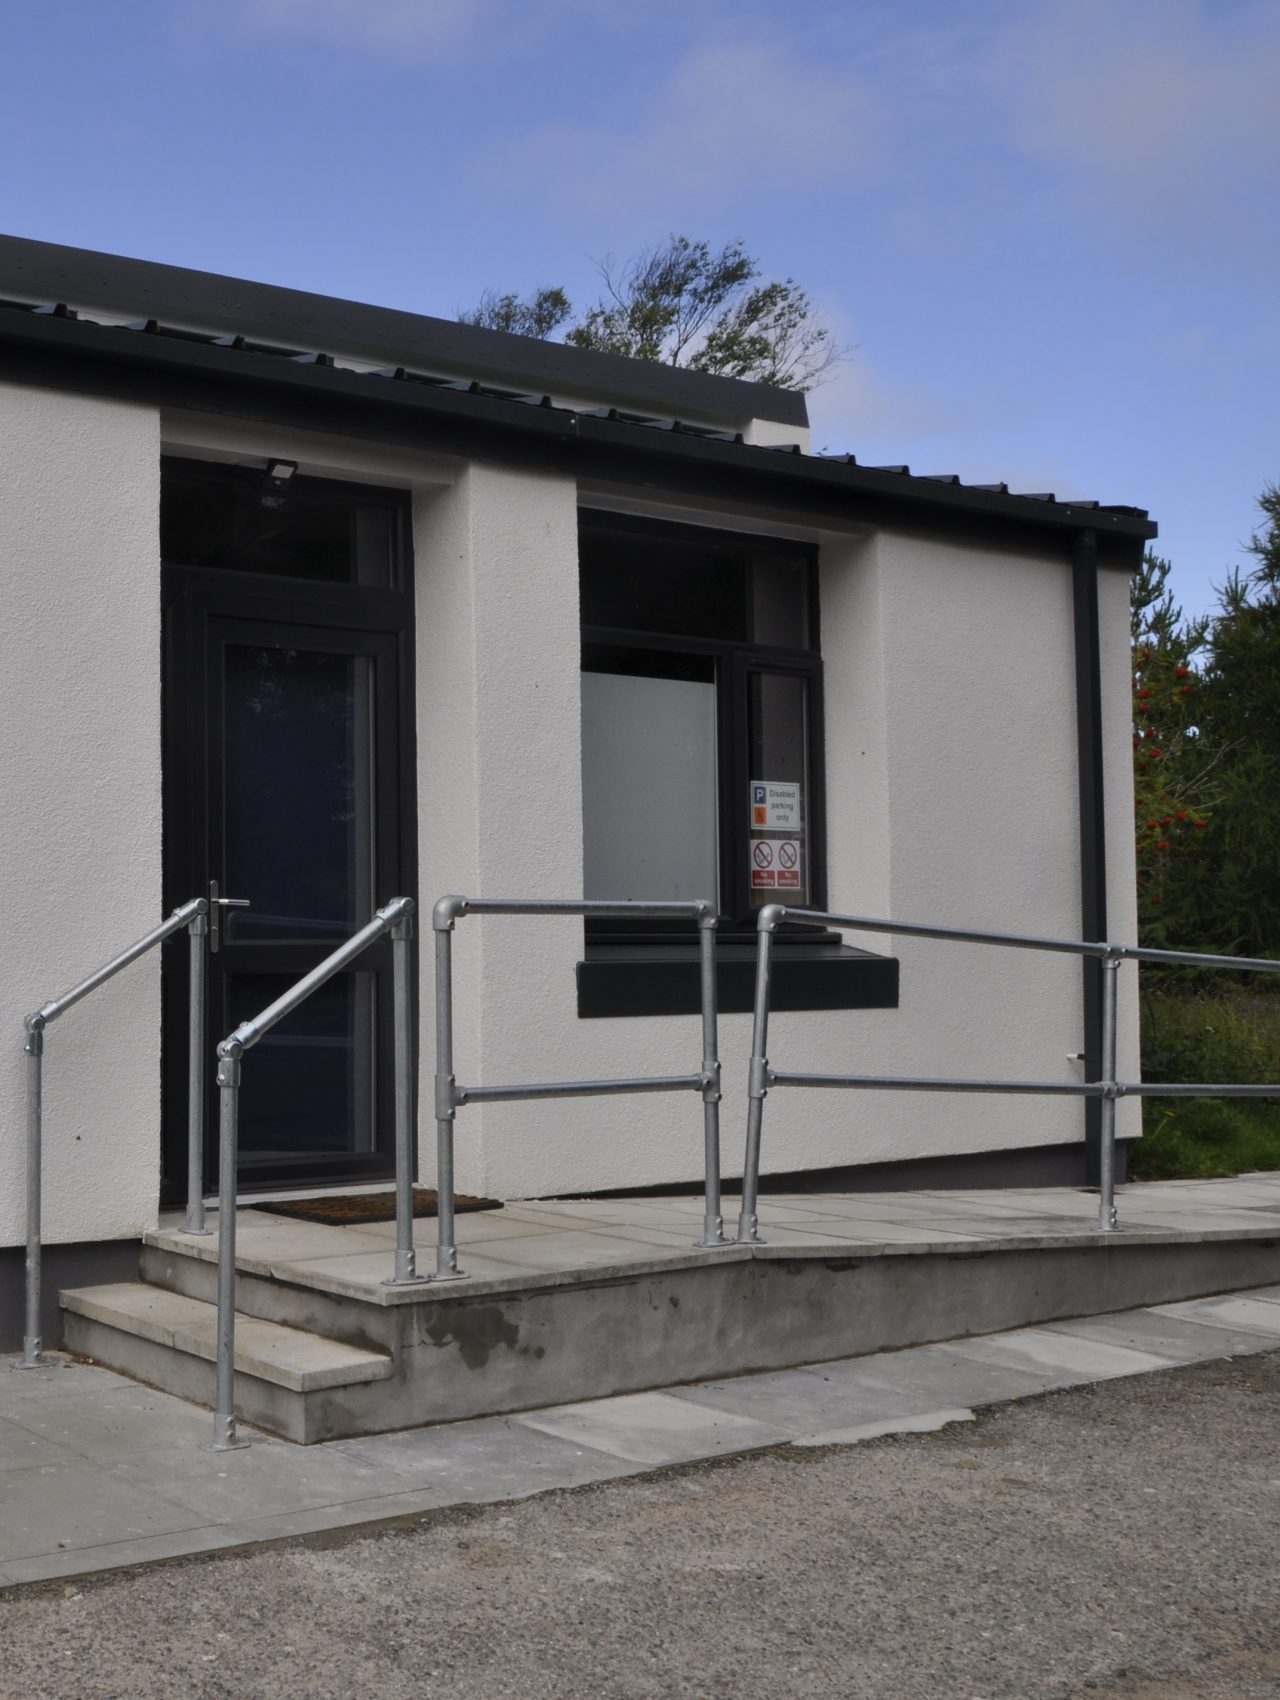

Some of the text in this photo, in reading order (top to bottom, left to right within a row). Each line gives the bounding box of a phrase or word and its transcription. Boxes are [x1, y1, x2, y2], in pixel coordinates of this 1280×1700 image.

[756, 788, 764, 801] P
[770, 789, 795, 798] Disabled
[771, 802, 793, 811] parking
[776, 814, 789, 822] only
